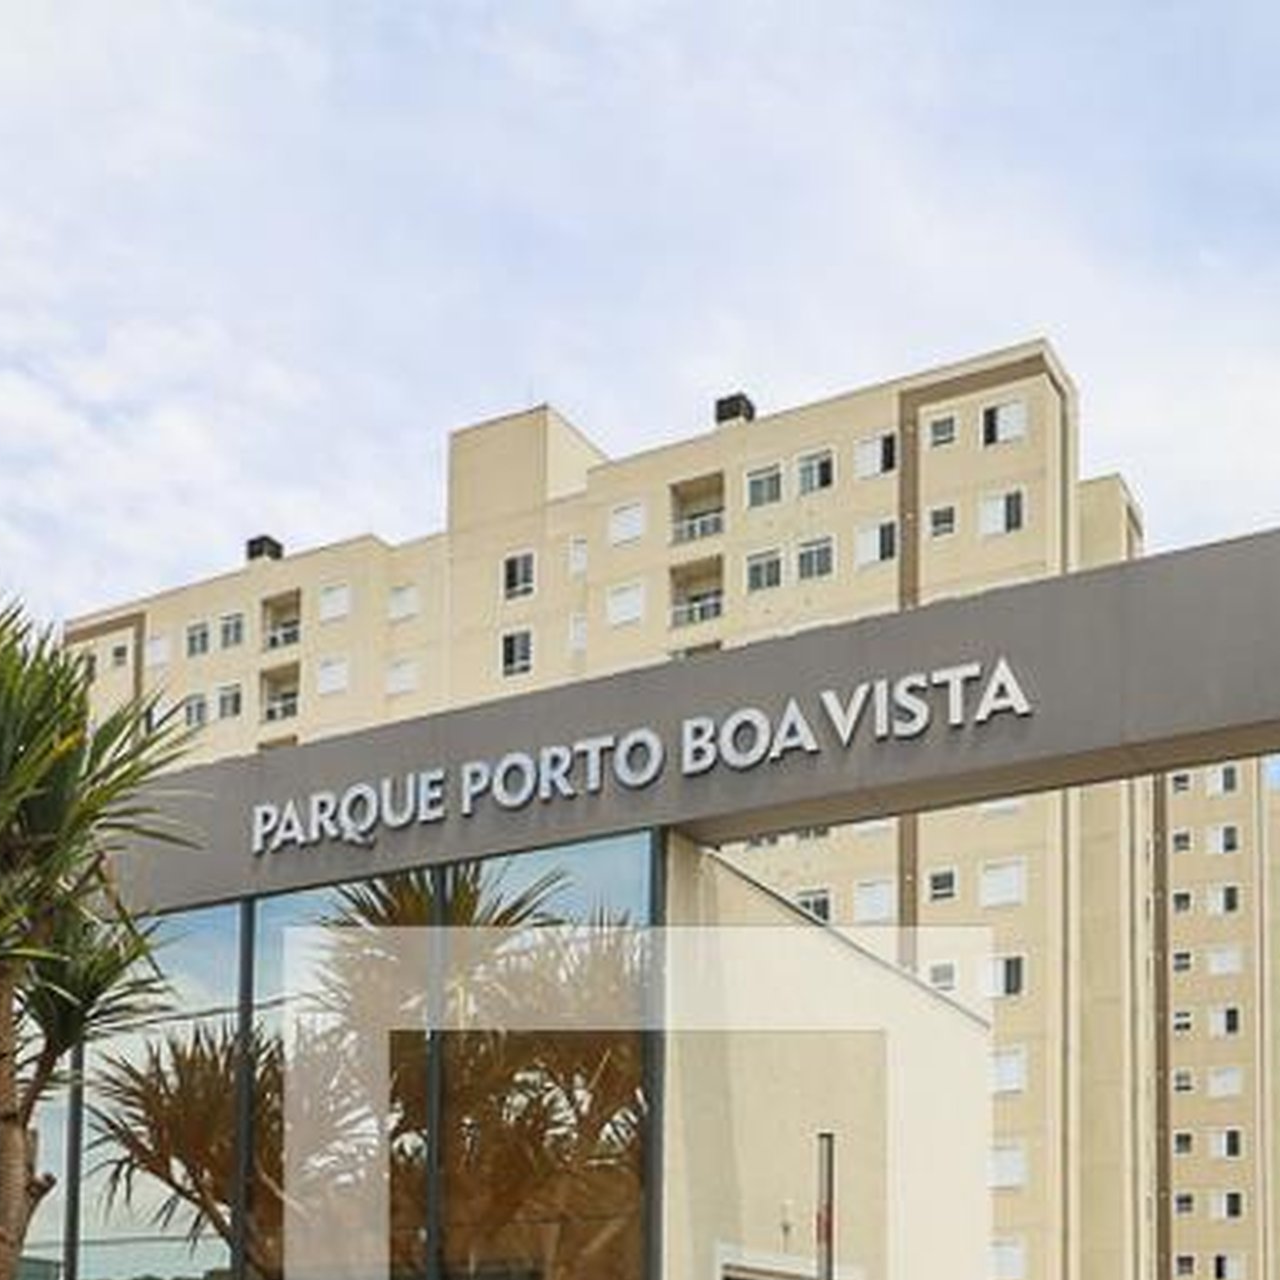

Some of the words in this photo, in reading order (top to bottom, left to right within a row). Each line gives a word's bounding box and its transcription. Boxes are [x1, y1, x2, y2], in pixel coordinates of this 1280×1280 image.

[251, 768, 446, 855] PARQUE
[461, 728, 665, 816] PORTO
[681, 697, 820, 775] BOA
[821, 656, 1032, 747] VISTA
